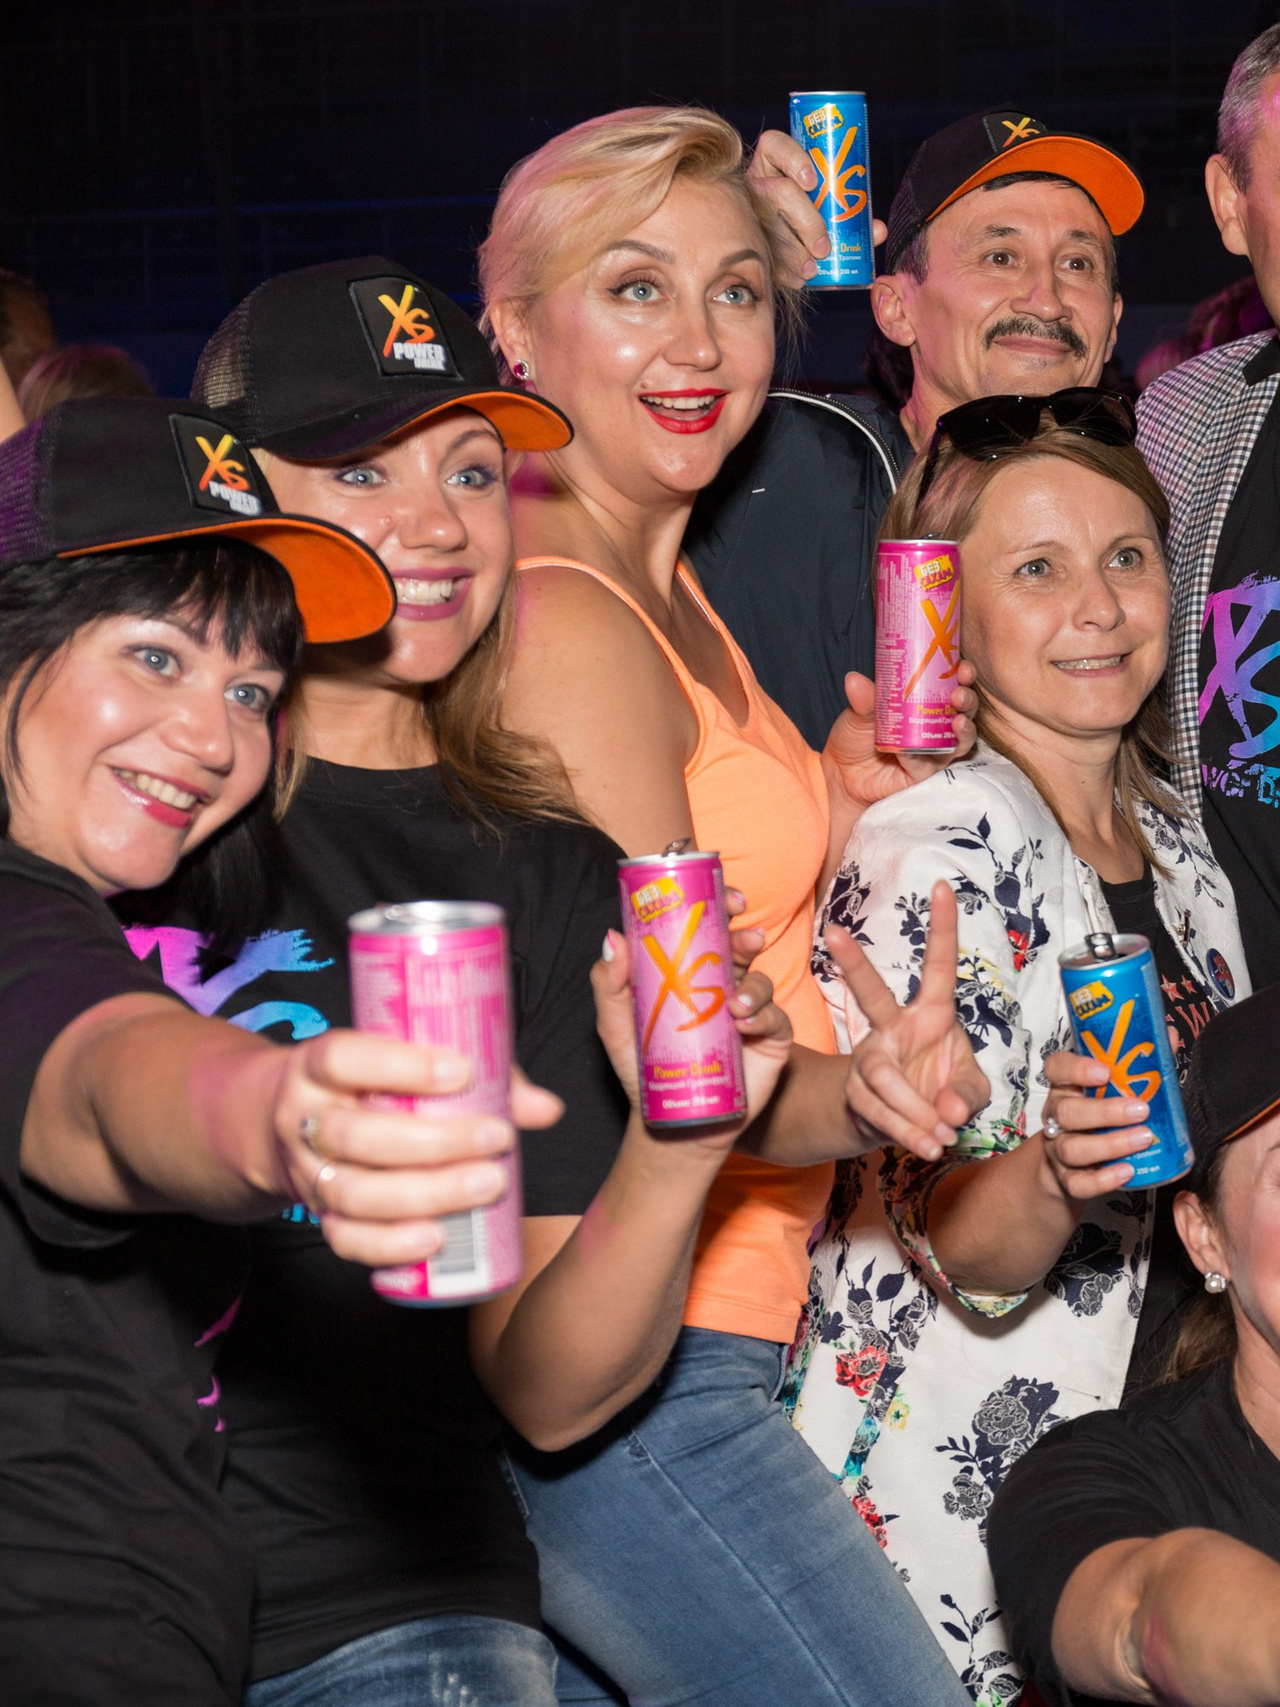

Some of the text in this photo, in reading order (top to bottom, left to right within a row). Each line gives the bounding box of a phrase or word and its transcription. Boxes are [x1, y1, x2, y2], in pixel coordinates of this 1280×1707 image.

[808, 126, 867, 223] XS
[378, 284, 436, 358] XS
[195, 433, 250, 491] XS
[920, 560, 941, 578] БЕЗ
[641, 900, 726, 1055] XS
